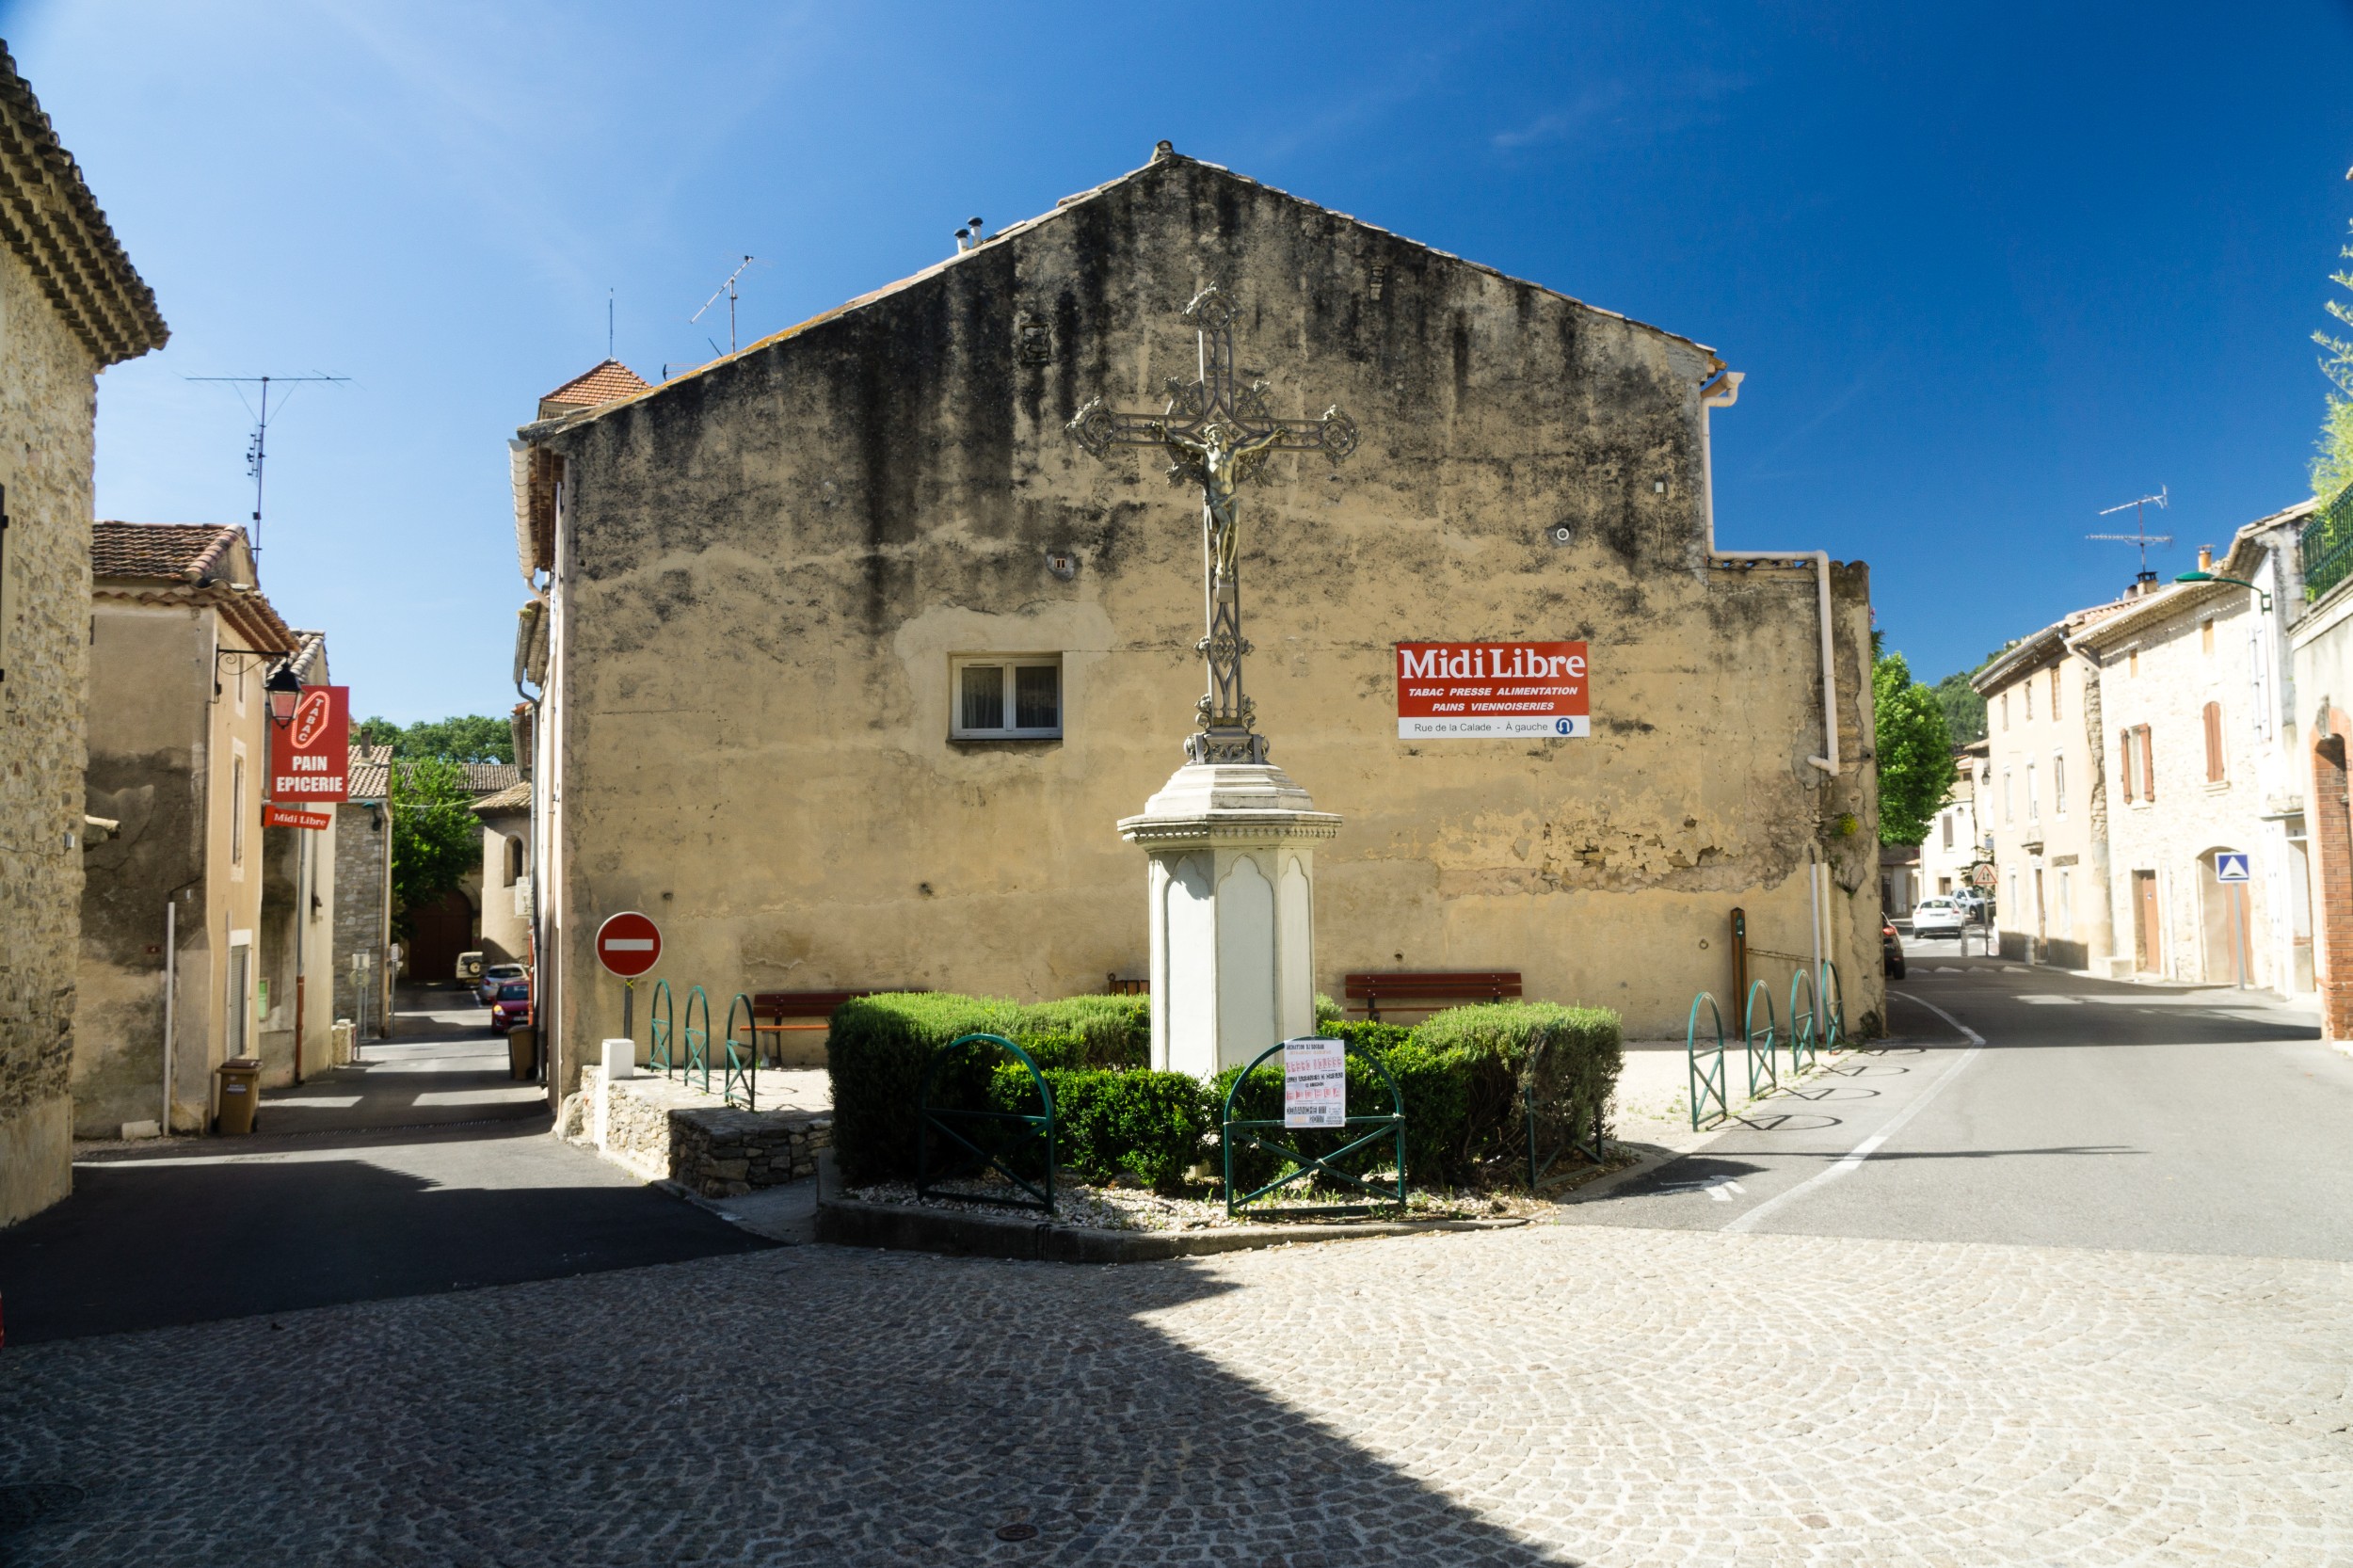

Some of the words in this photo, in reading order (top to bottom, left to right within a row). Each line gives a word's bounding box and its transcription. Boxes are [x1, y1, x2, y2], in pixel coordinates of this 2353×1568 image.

[1400, 648, 1486, 680] Midi
[1489, 648, 1586, 679] Libre
[1408, 688, 1445, 697] TABAC
[1449, 687, 1492, 696] PRESSE
[1497, 686, 1578, 696] ALIMENTATION
[1432, 703, 1465, 712] PAINS
[1471, 702, 1555, 712] VIENNOISERIES
[298, 698, 324, 742] TABAC
[1415, 723, 1433, 732] Rue
[1435, 723, 1447, 732] de
[1449, 723, 1457, 732] la
[1460, 723, 1492, 732] Calade
[1505, 721, 1513, 731] À
[1514, 722, 1548, 734] gauche
[292, 756, 328, 772] PAIN
[276, 776, 344, 792] EPICERIE
[273, 812, 297, 824] Midi
[299, 814, 327, 826] Libre
